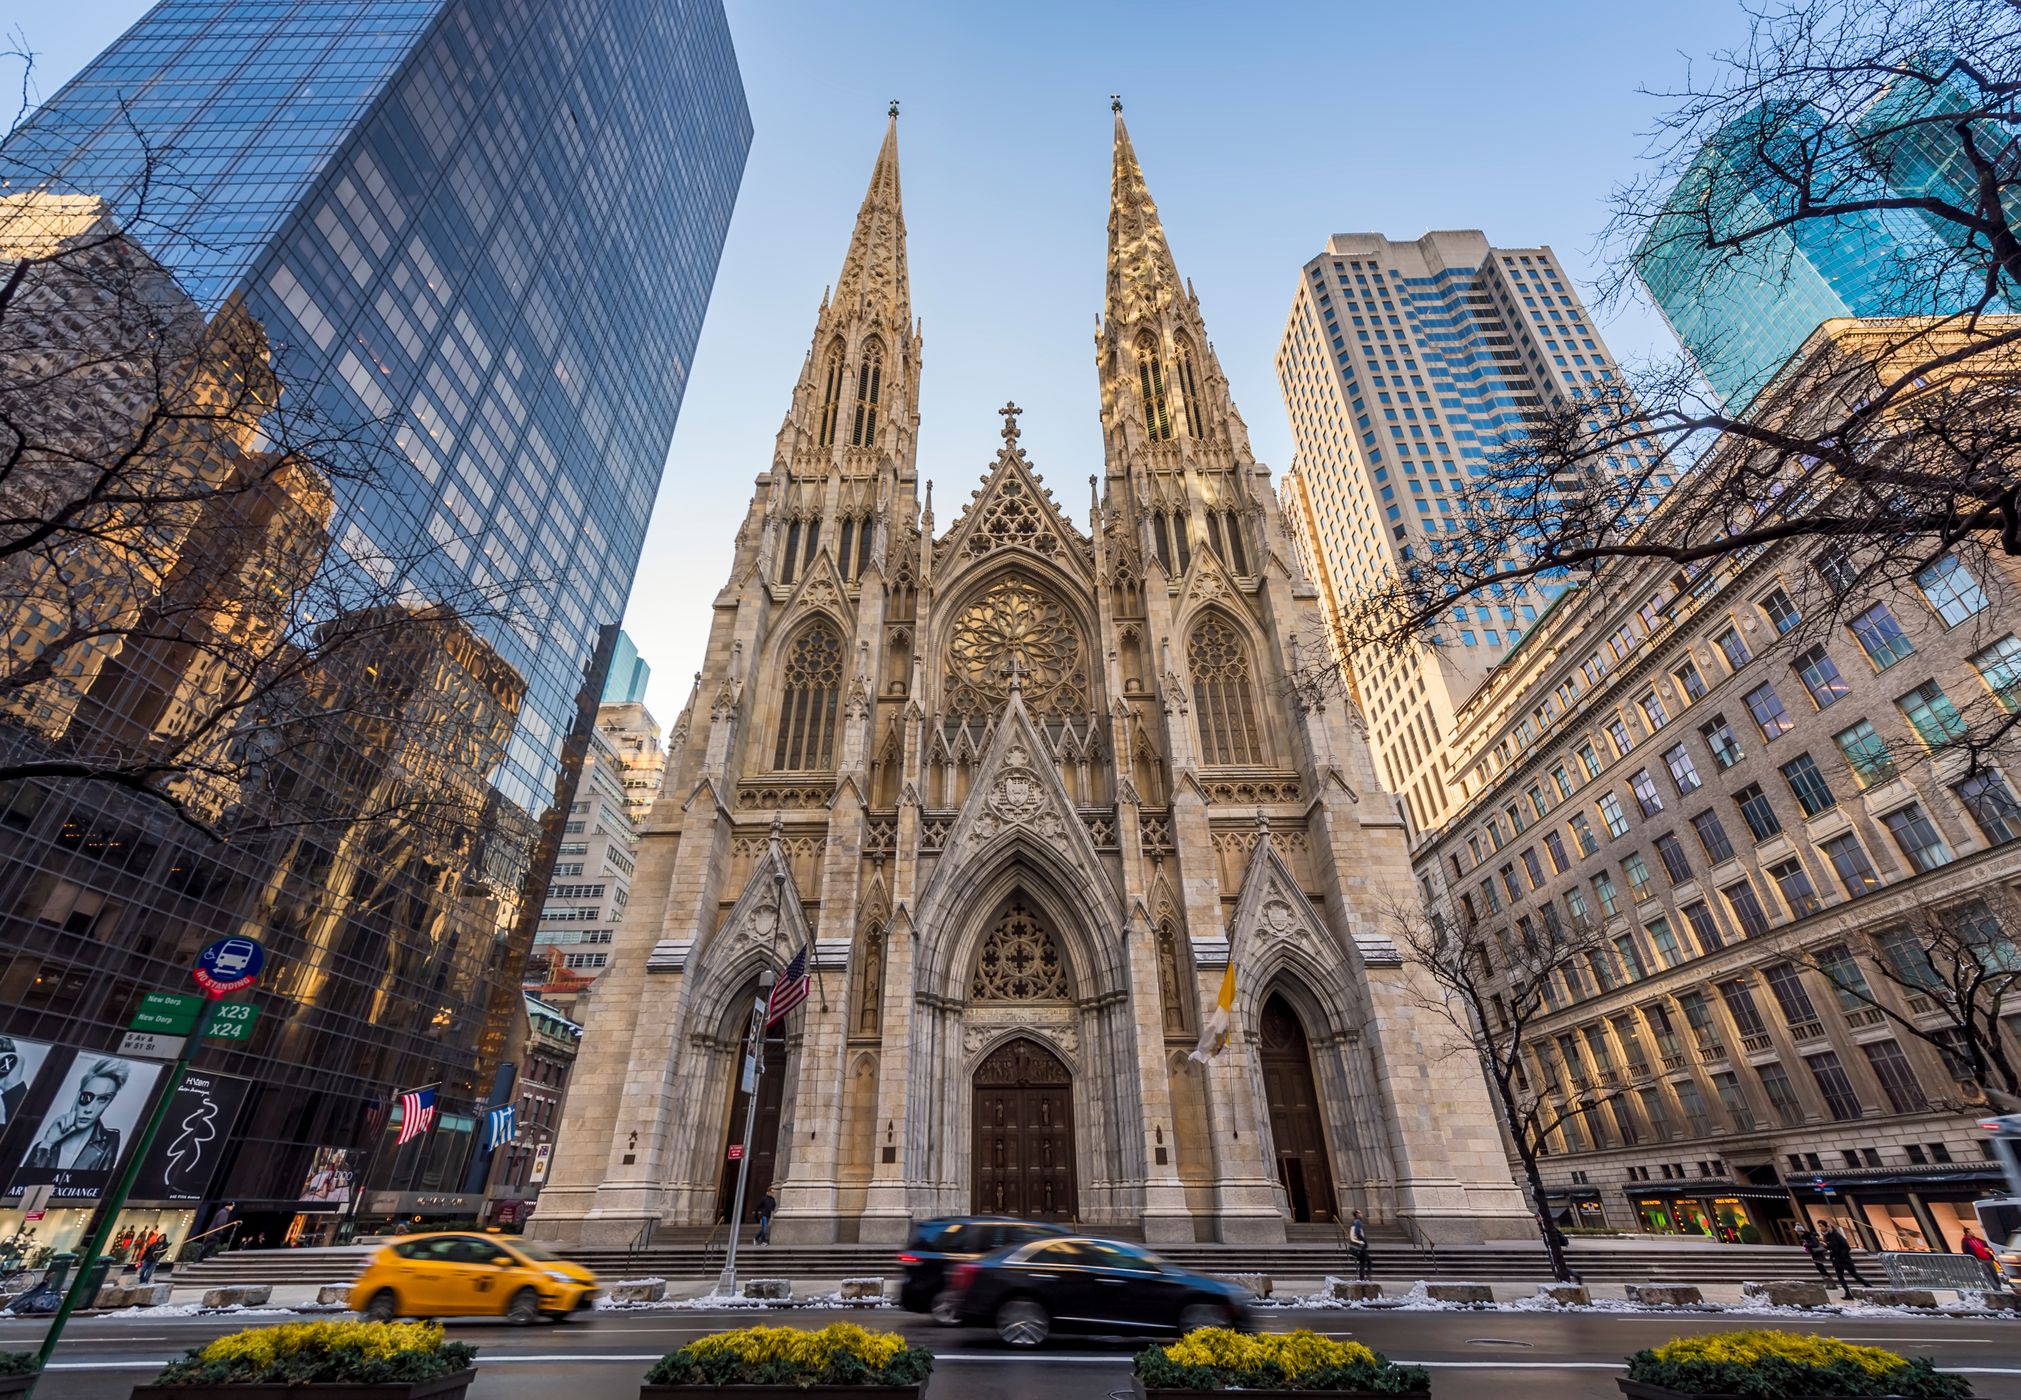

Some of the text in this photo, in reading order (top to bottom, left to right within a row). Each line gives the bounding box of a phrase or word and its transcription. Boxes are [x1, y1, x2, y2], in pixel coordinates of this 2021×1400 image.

[196, 970, 250, 990] NO STANDING
[147, 995, 182, 1006] New Dorp
[138, 1013, 173, 1024] New Dorp
[50, 1187, 100, 1197] EXCHANGE
